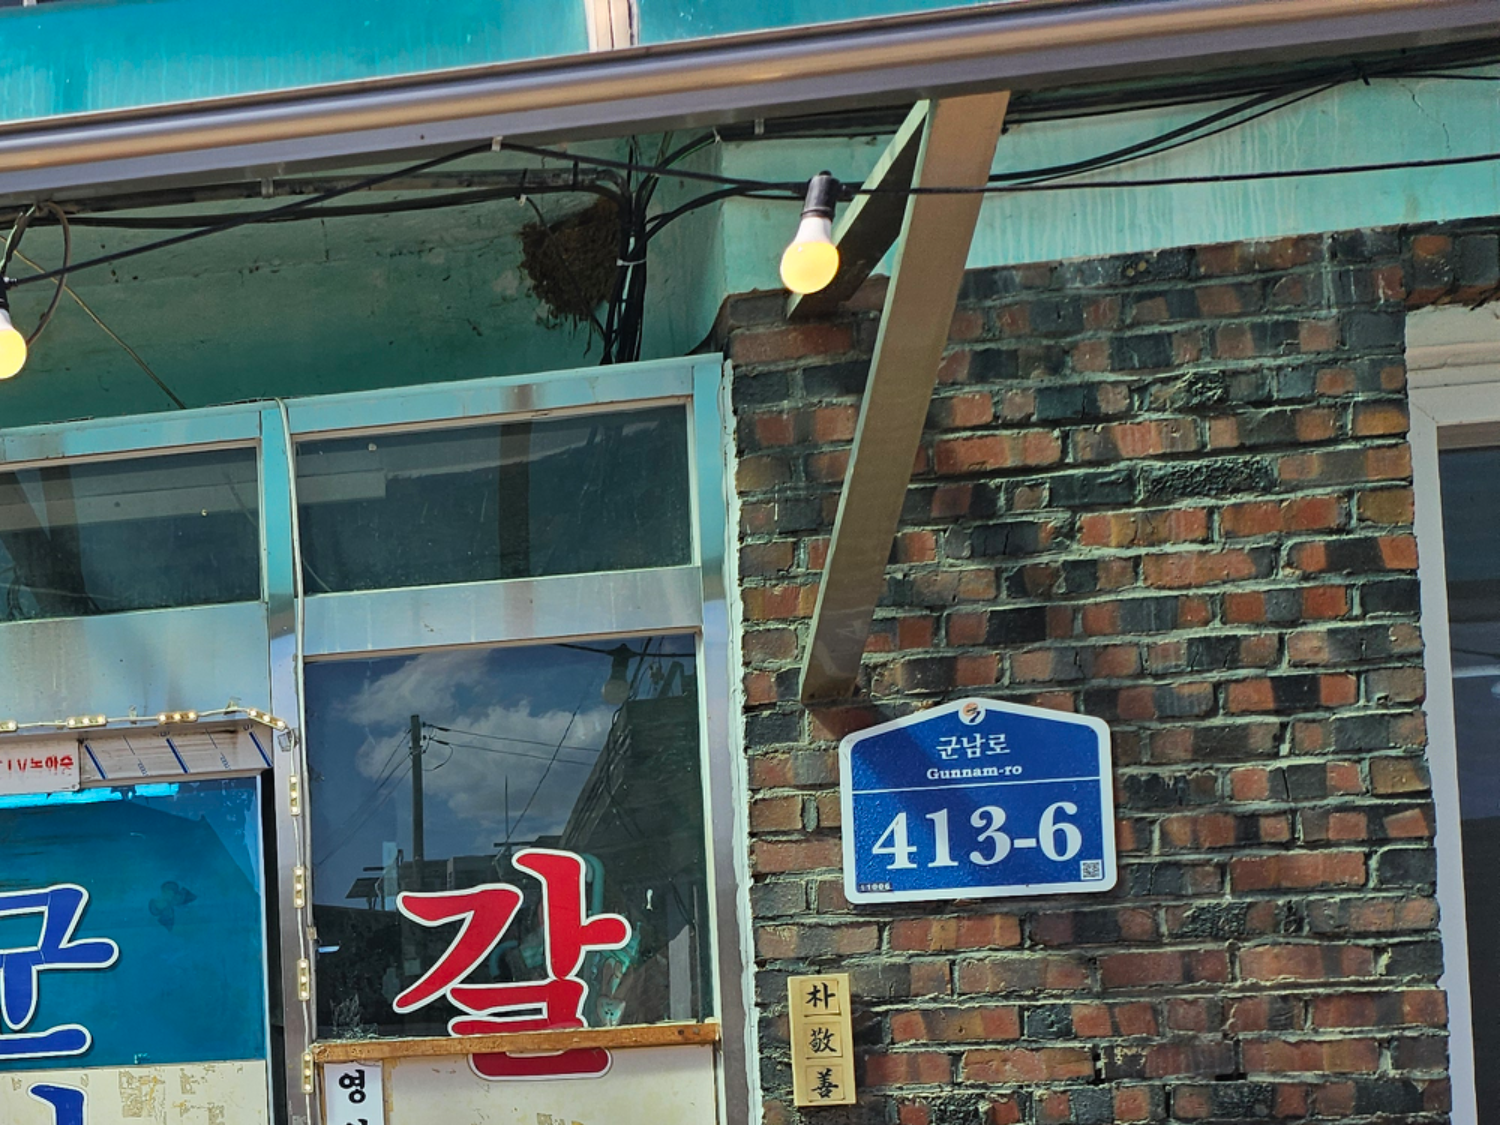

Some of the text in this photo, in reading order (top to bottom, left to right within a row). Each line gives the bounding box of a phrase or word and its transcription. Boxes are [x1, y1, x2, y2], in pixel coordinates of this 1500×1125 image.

[936, 733, 1011, 760] 군남로
[926, 764, 1023, 781] Gunnam-ro
[871, 801, 1083, 870] 413-6
[804, 980, 840, 1100] 朴敬善
